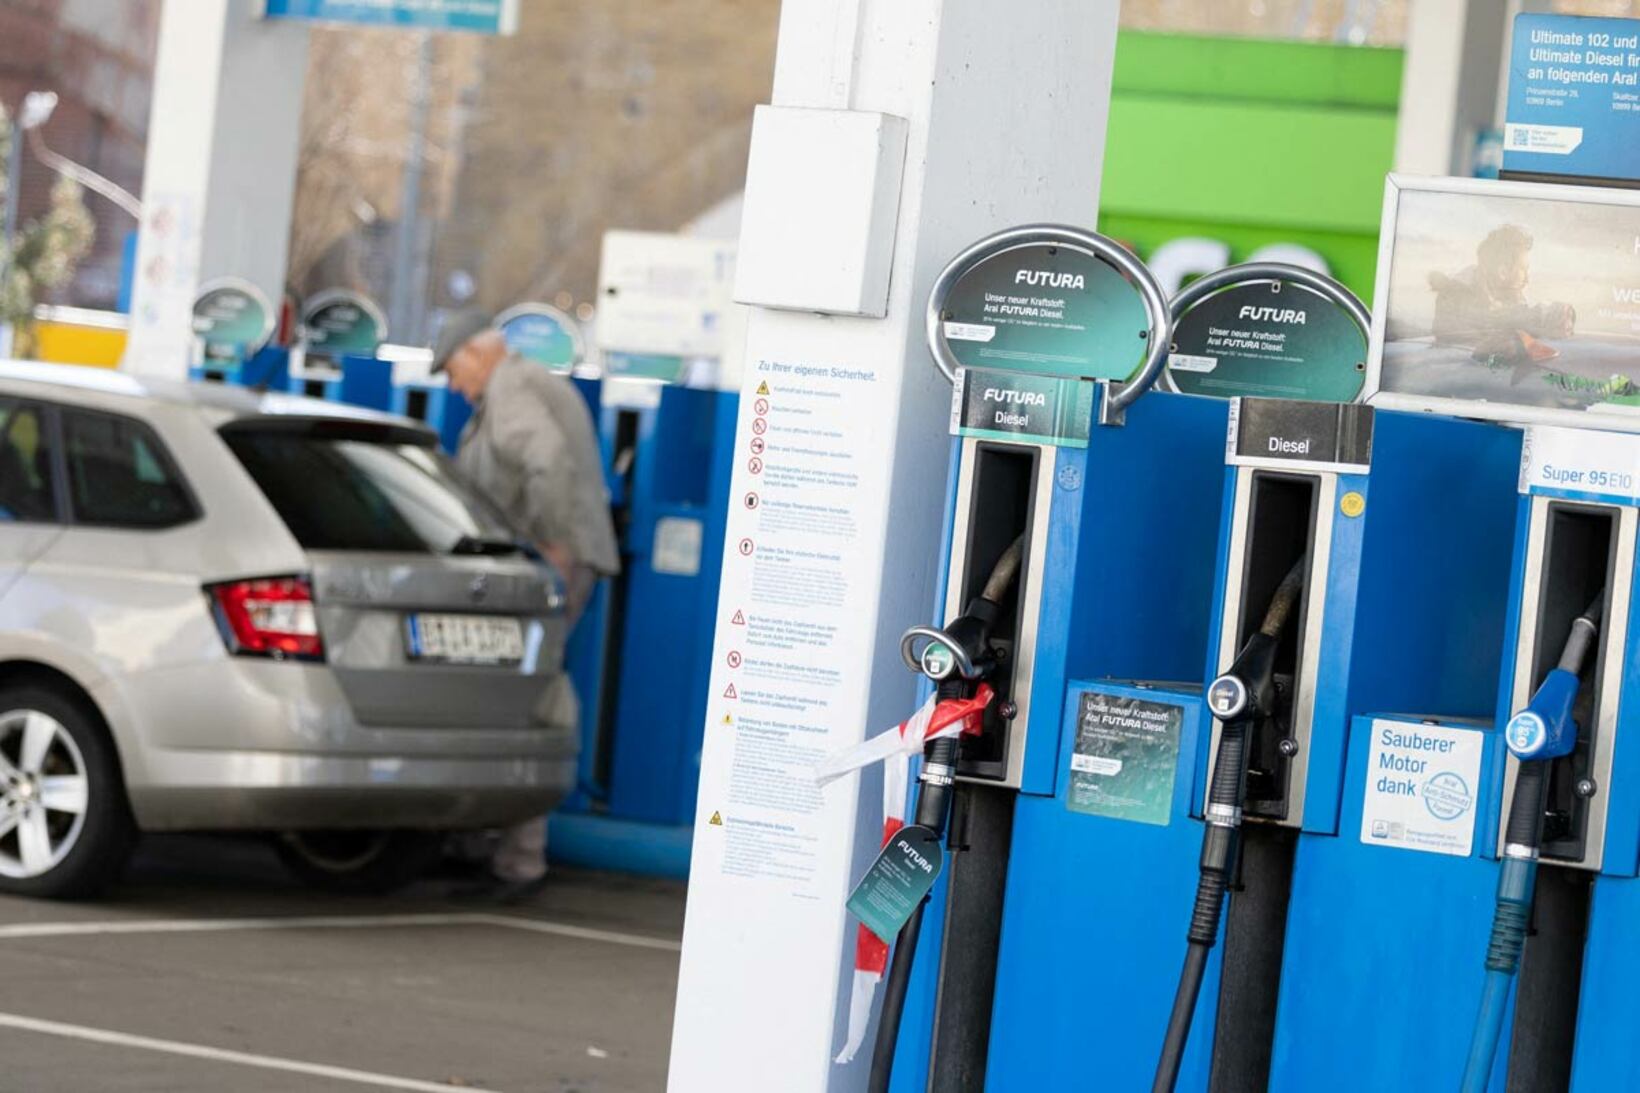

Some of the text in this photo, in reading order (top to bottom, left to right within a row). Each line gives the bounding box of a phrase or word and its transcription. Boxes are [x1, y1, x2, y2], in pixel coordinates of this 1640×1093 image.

[1531, 30, 1638, 49] Ultimate 102 und
[1530, 48, 1582, 63] Ultimate
[1586, 51, 1624, 66] Diesel
[1527, 66, 1638, 85] an folgenden Aral
[1014, 269, 1085, 290] FUTURA
[984, 292, 1006, 303] Unser
[1007, 296, 1029, 305] neuer
[983, 304, 999, 313] Aral
[1000, 305, 1039, 317] FUTURA
[1239, 305, 1306, 325] FUTURA
[1208, 327, 1230, 337] Unser
[1230, 330, 1251, 339] neuer
[1207, 337, 1222, 346] Aral
[1223, 338, 1260, 350] FUTURA
[758, 360, 877, 381] Zu Ihrer eigenen Sicherheit.
[983, 388, 1045, 407] FUTURA
[995, 410, 1029, 427] Diesel
[1268, 436, 1310, 454] Diesel
[1542, 465, 1632, 489] Super 95 E10
[1086, 701, 1108, 713] Unser
[1110, 705, 1131, 716] neuer
[1085, 713, 1101, 723] Aral
[1102, 715, 1142, 729] FUTURA
[1381, 728, 1456, 753] Sauberer
[1379, 752, 1428, 774] Motor
[1376, 776, 1417, 797] dank
[897, 840, 934, 874] FUTURA
